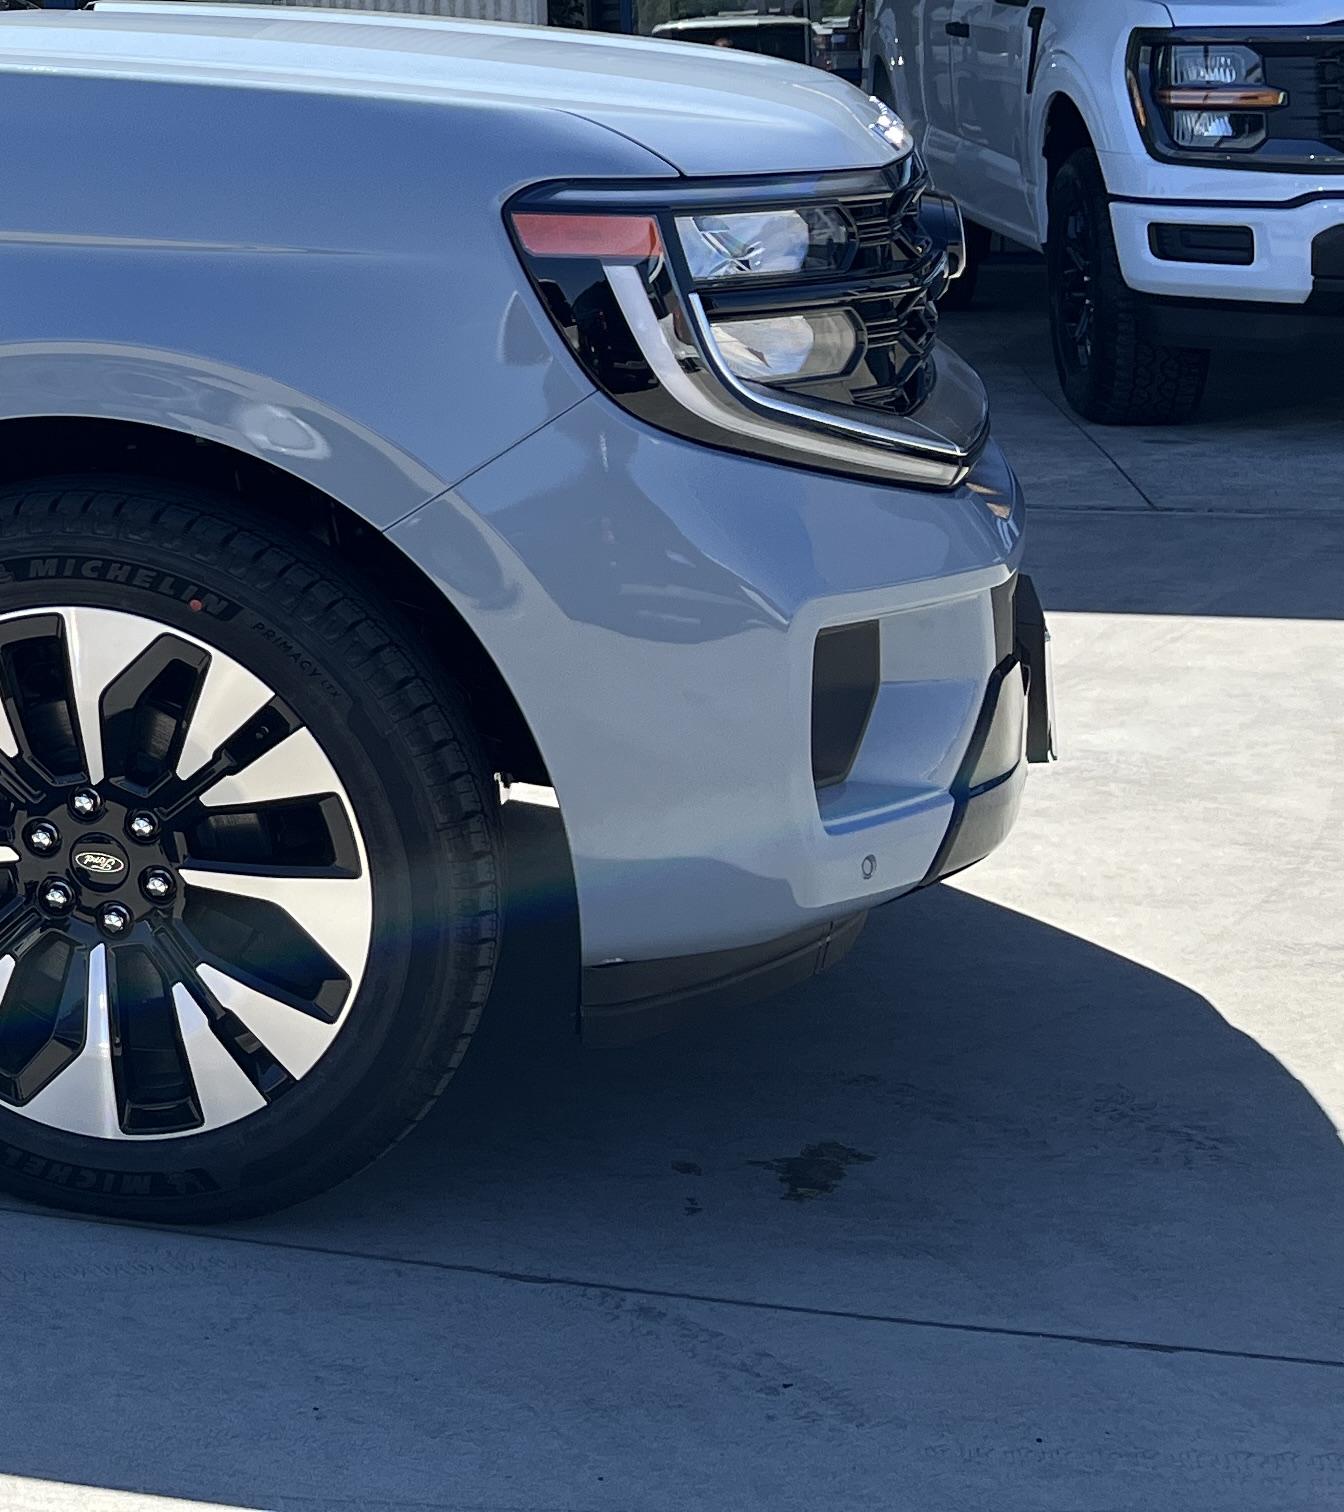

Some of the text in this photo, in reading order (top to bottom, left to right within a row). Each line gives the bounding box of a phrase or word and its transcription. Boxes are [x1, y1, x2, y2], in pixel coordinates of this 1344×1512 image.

[28, 558, 229, 619] MICHELIN
[252, 621, 322, 678] PRIMACY
[83, 854, 116, 871] Ford
